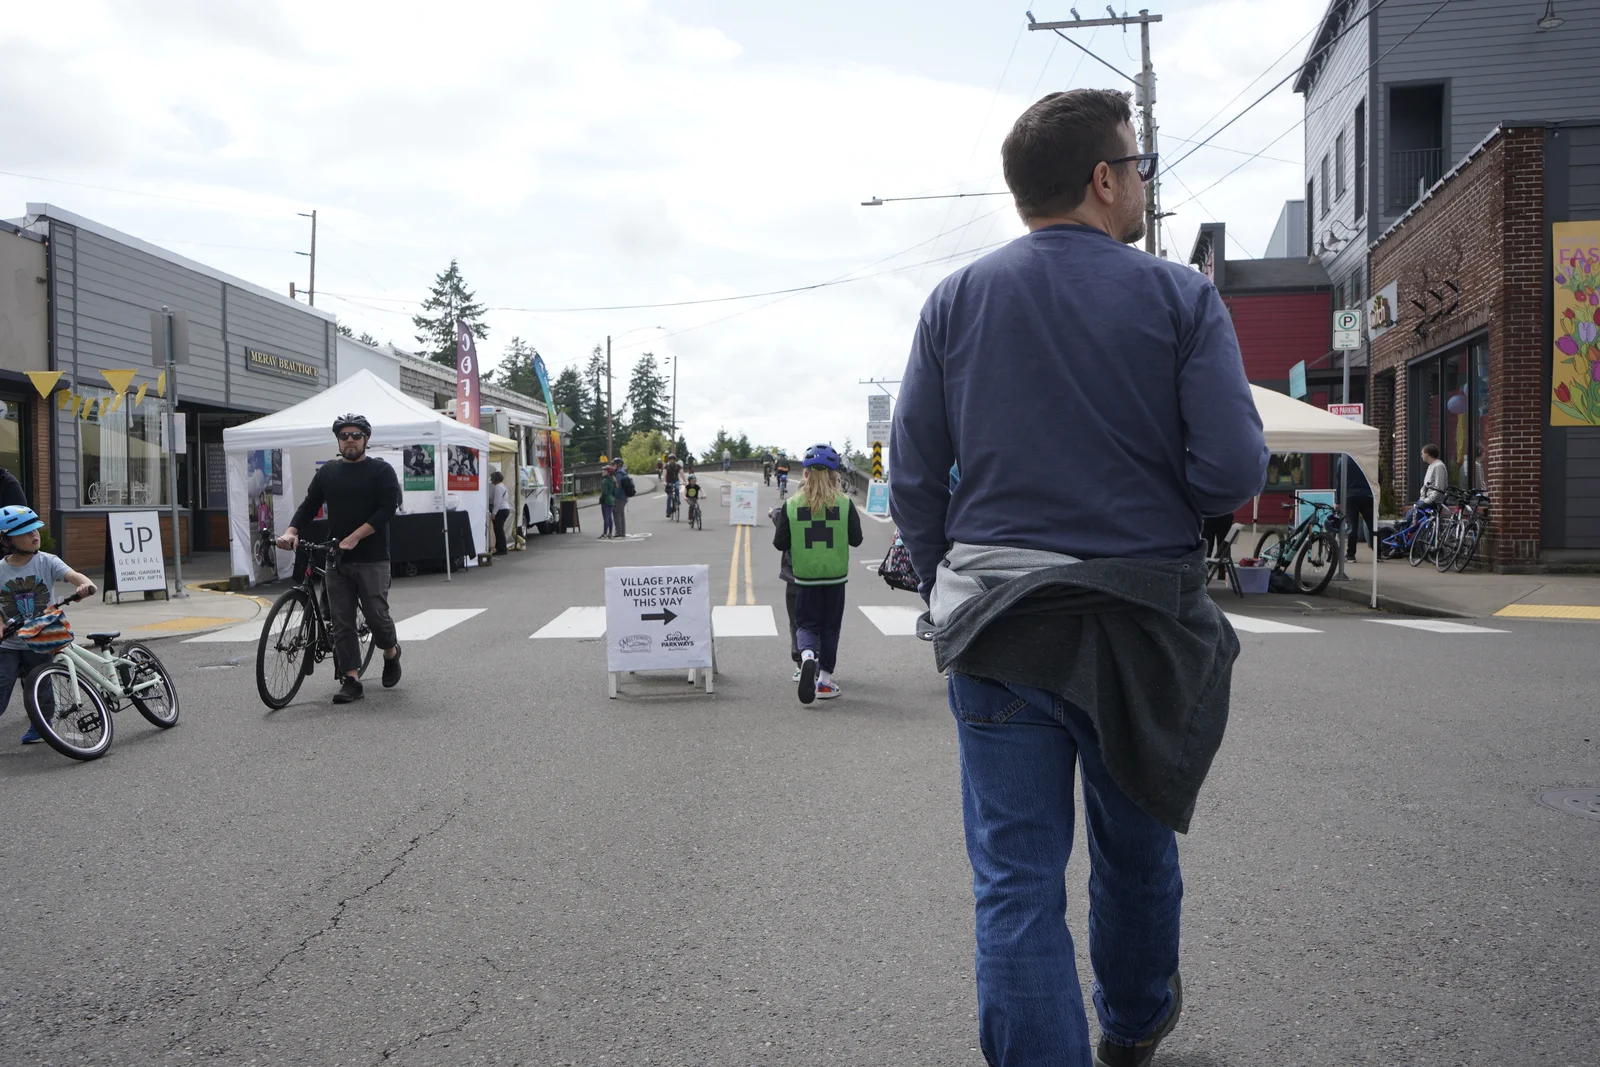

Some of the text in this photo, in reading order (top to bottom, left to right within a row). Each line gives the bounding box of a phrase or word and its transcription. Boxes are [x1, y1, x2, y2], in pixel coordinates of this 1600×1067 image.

[1343, 316, 1353, 327] P
[250, 350, 319, 377] MERAV BEAUTIQUE
[1339, 406, 1359, 414] PARKING
[119, 522, 153, 554] JP
[118, 557, 160, 566] GENERAL
[620, 575, 694, 587] VILLAGE PARK
[623, 586, 692, 597] MUSIC STAGE
[633, 597, 683, 607] THIS WAY
[661, 640, 695, 648] PARKWAYS
